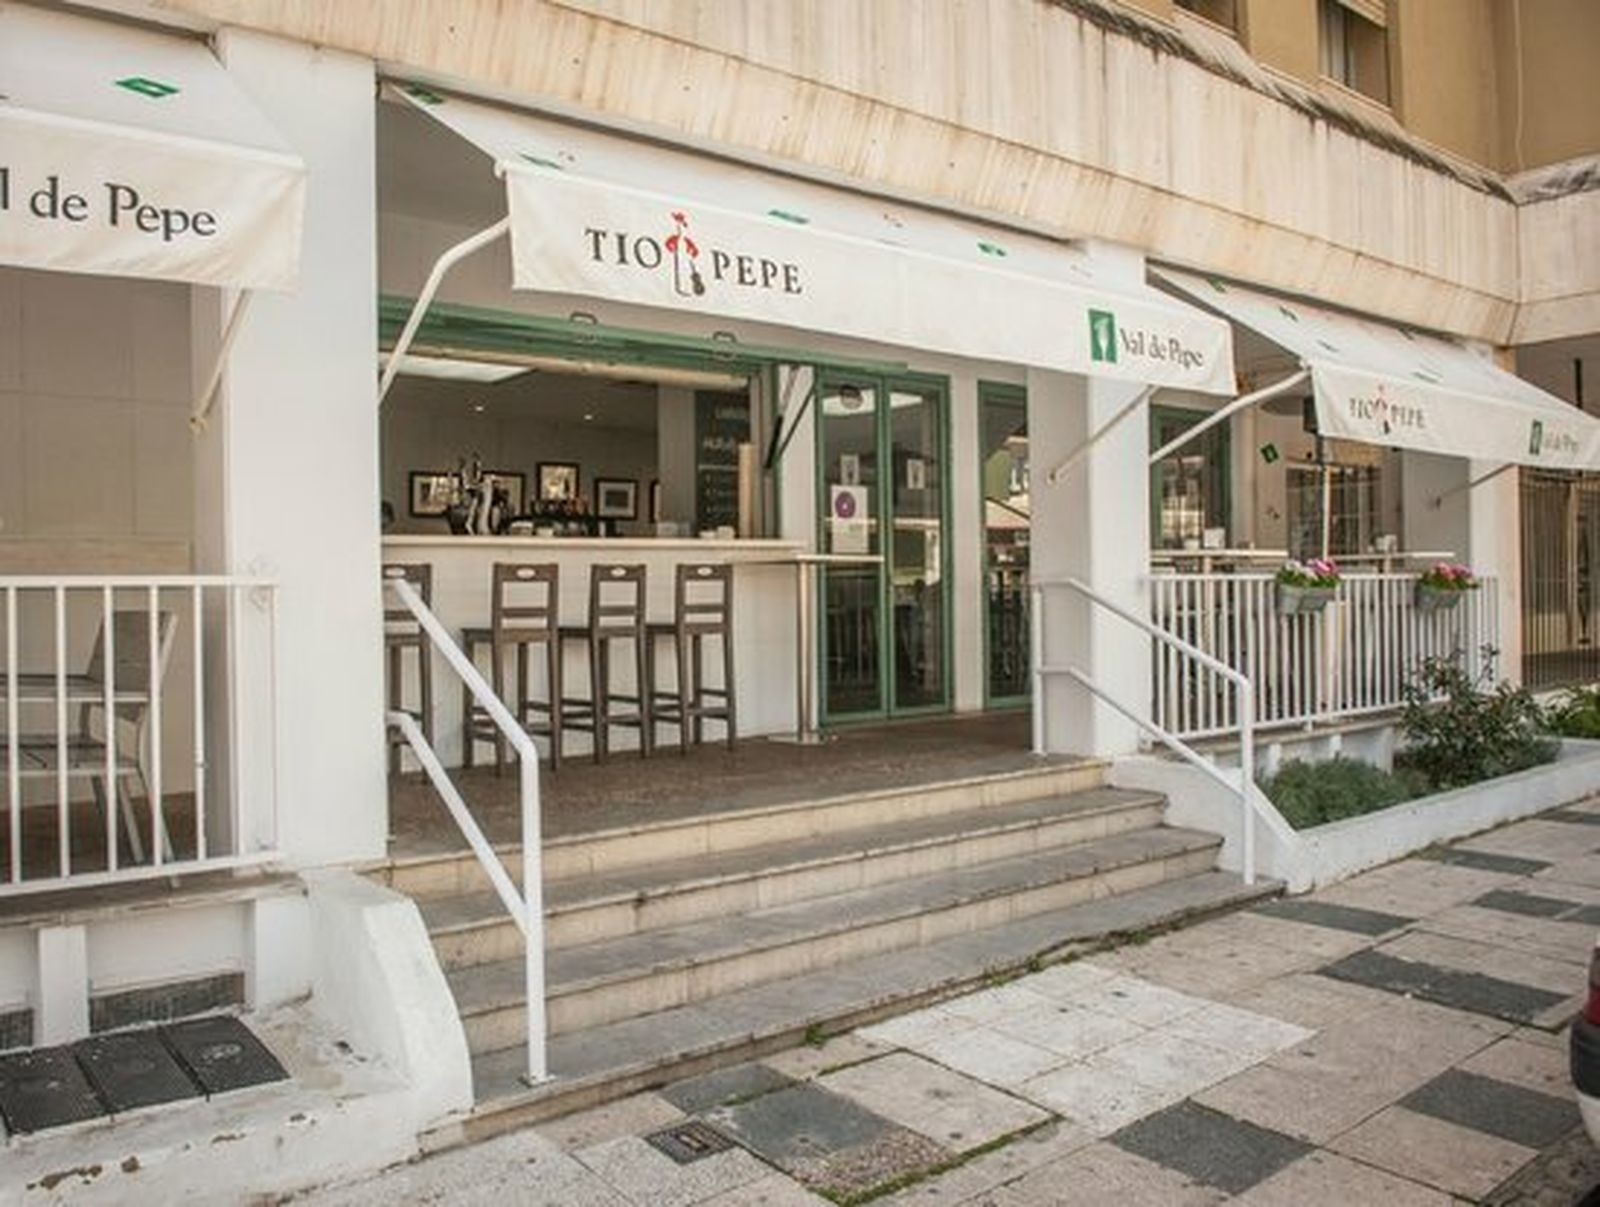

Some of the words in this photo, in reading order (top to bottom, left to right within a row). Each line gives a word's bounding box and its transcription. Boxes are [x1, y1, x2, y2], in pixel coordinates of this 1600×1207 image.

[30, 176, 88, 222] de
[103, 182, 217, 242] Pepe
[585, 228, 662, 269] TIO
[710, 249, 803, 294] PEPE
[1120, 327, 1145, 356] Val
[1148, 334, 1167, 361] de
